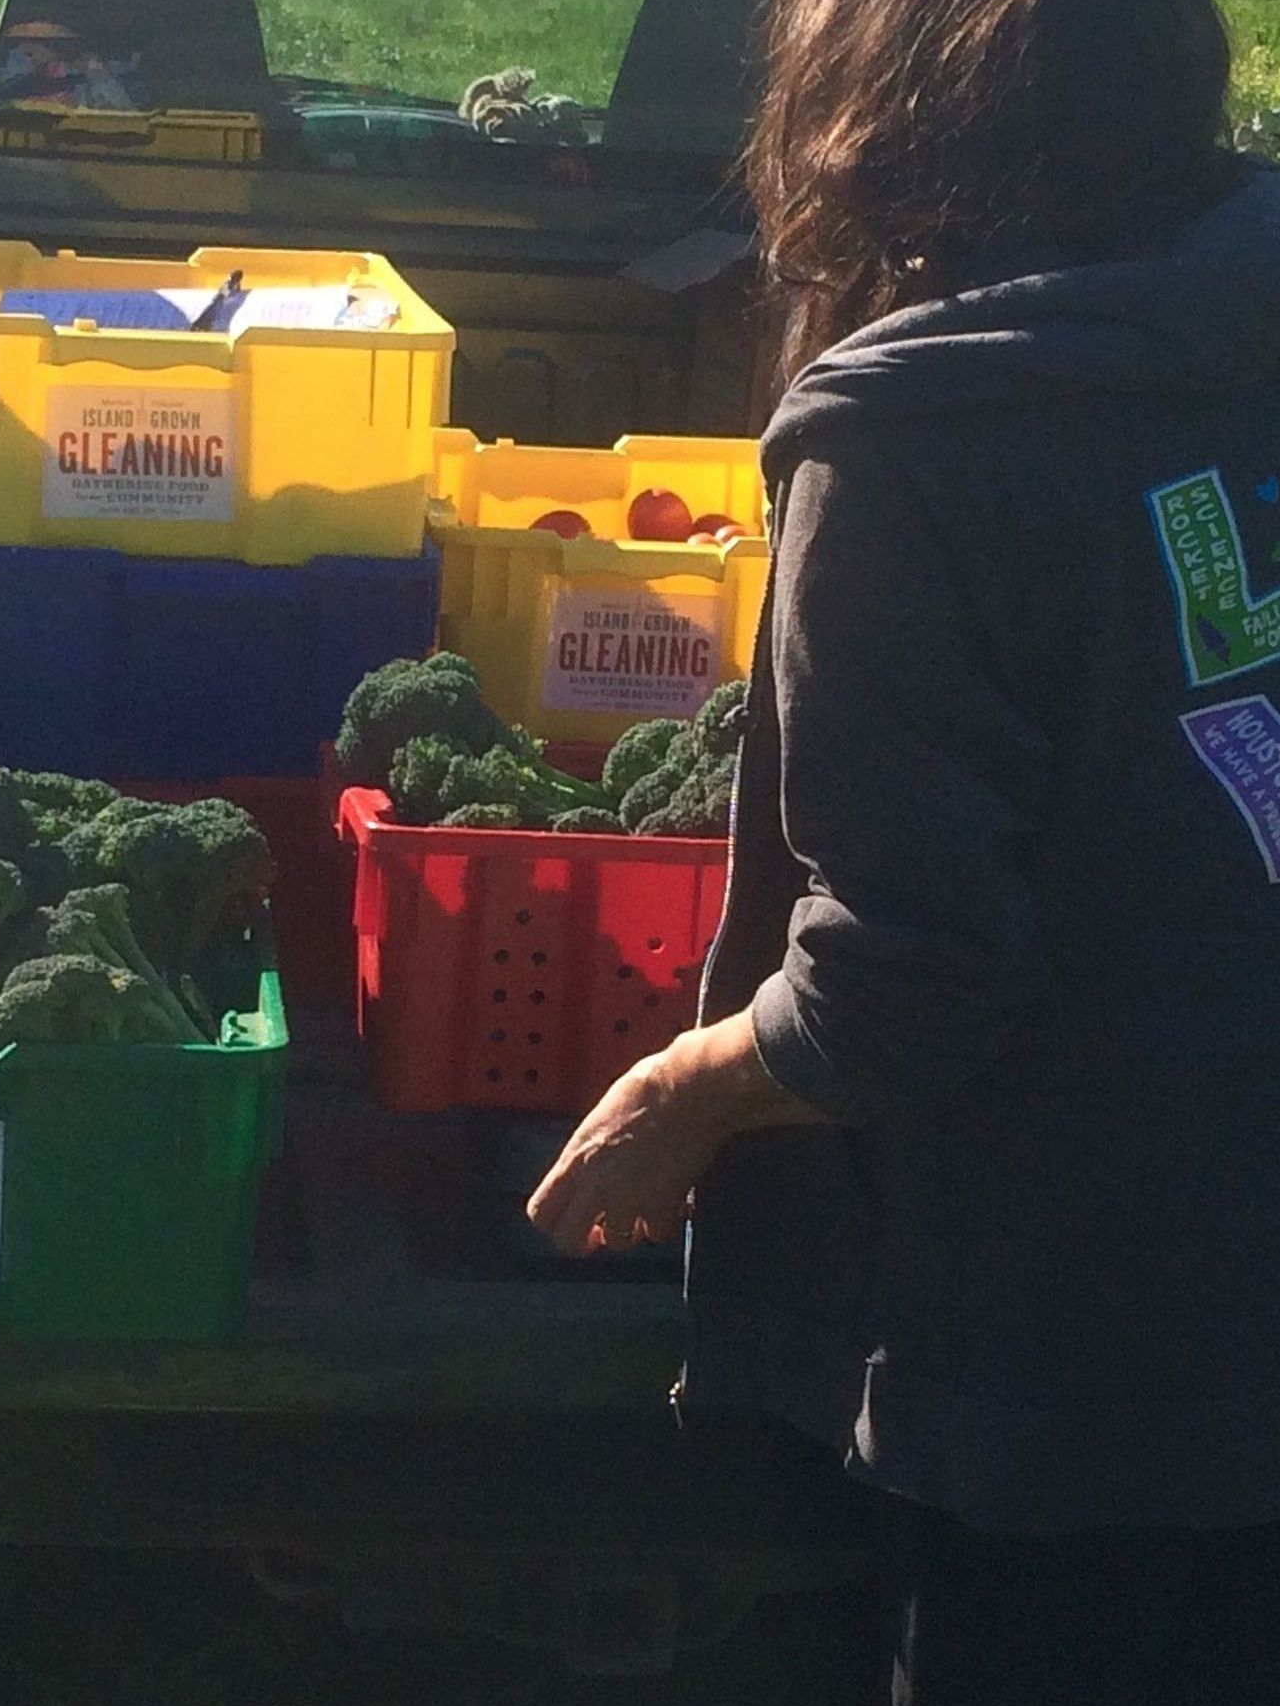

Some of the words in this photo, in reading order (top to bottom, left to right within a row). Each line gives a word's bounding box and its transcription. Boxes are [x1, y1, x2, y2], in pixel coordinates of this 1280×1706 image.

[83, 408, 133, 427] ISLAND
[151, 411, 200, 430] GROWN
[58, 431, 224, 478] GLEANING
[1167, 495, 1212, 601] ROCKET
[1190, 484, 1237, 611] SCIENCE
[583, 610, 629, 630] ISLAND
[644, 614, 691, 634] GROWN
[558, 632, 710, 677] GLEANING
[1205, 724, 1227, 749] WE
[1221, 747, 1258, 786] HAVE
[1252, 789, 1266, 801] A
